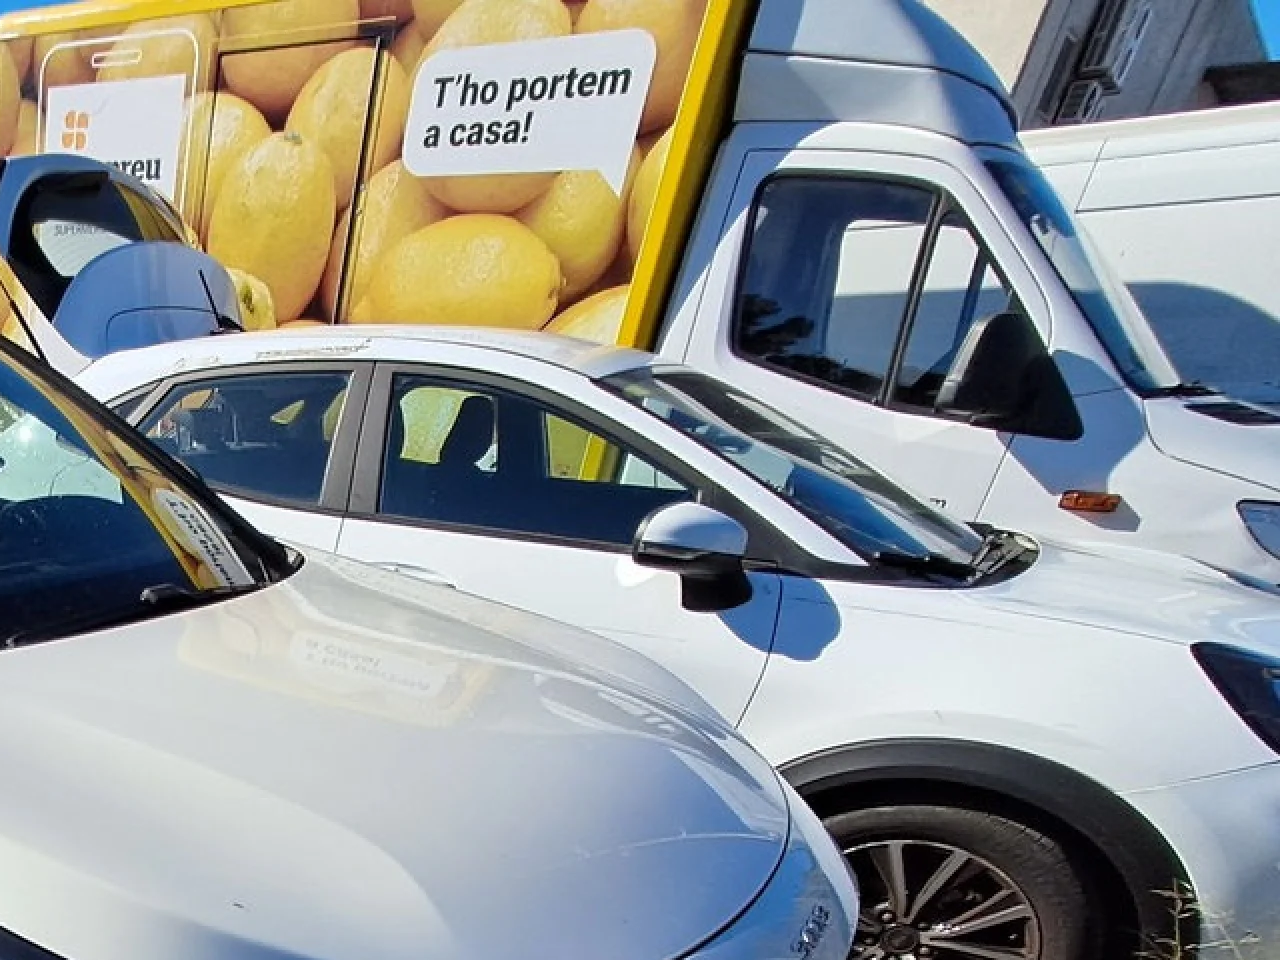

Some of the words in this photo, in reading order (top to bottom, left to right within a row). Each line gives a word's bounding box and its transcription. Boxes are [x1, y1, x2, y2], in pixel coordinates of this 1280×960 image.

[505, 67, 632, 112] portem
[423, 124, 441, 148] a
[449, 111, 535, 147] casa!
[113, 158, 161, 181] reu
